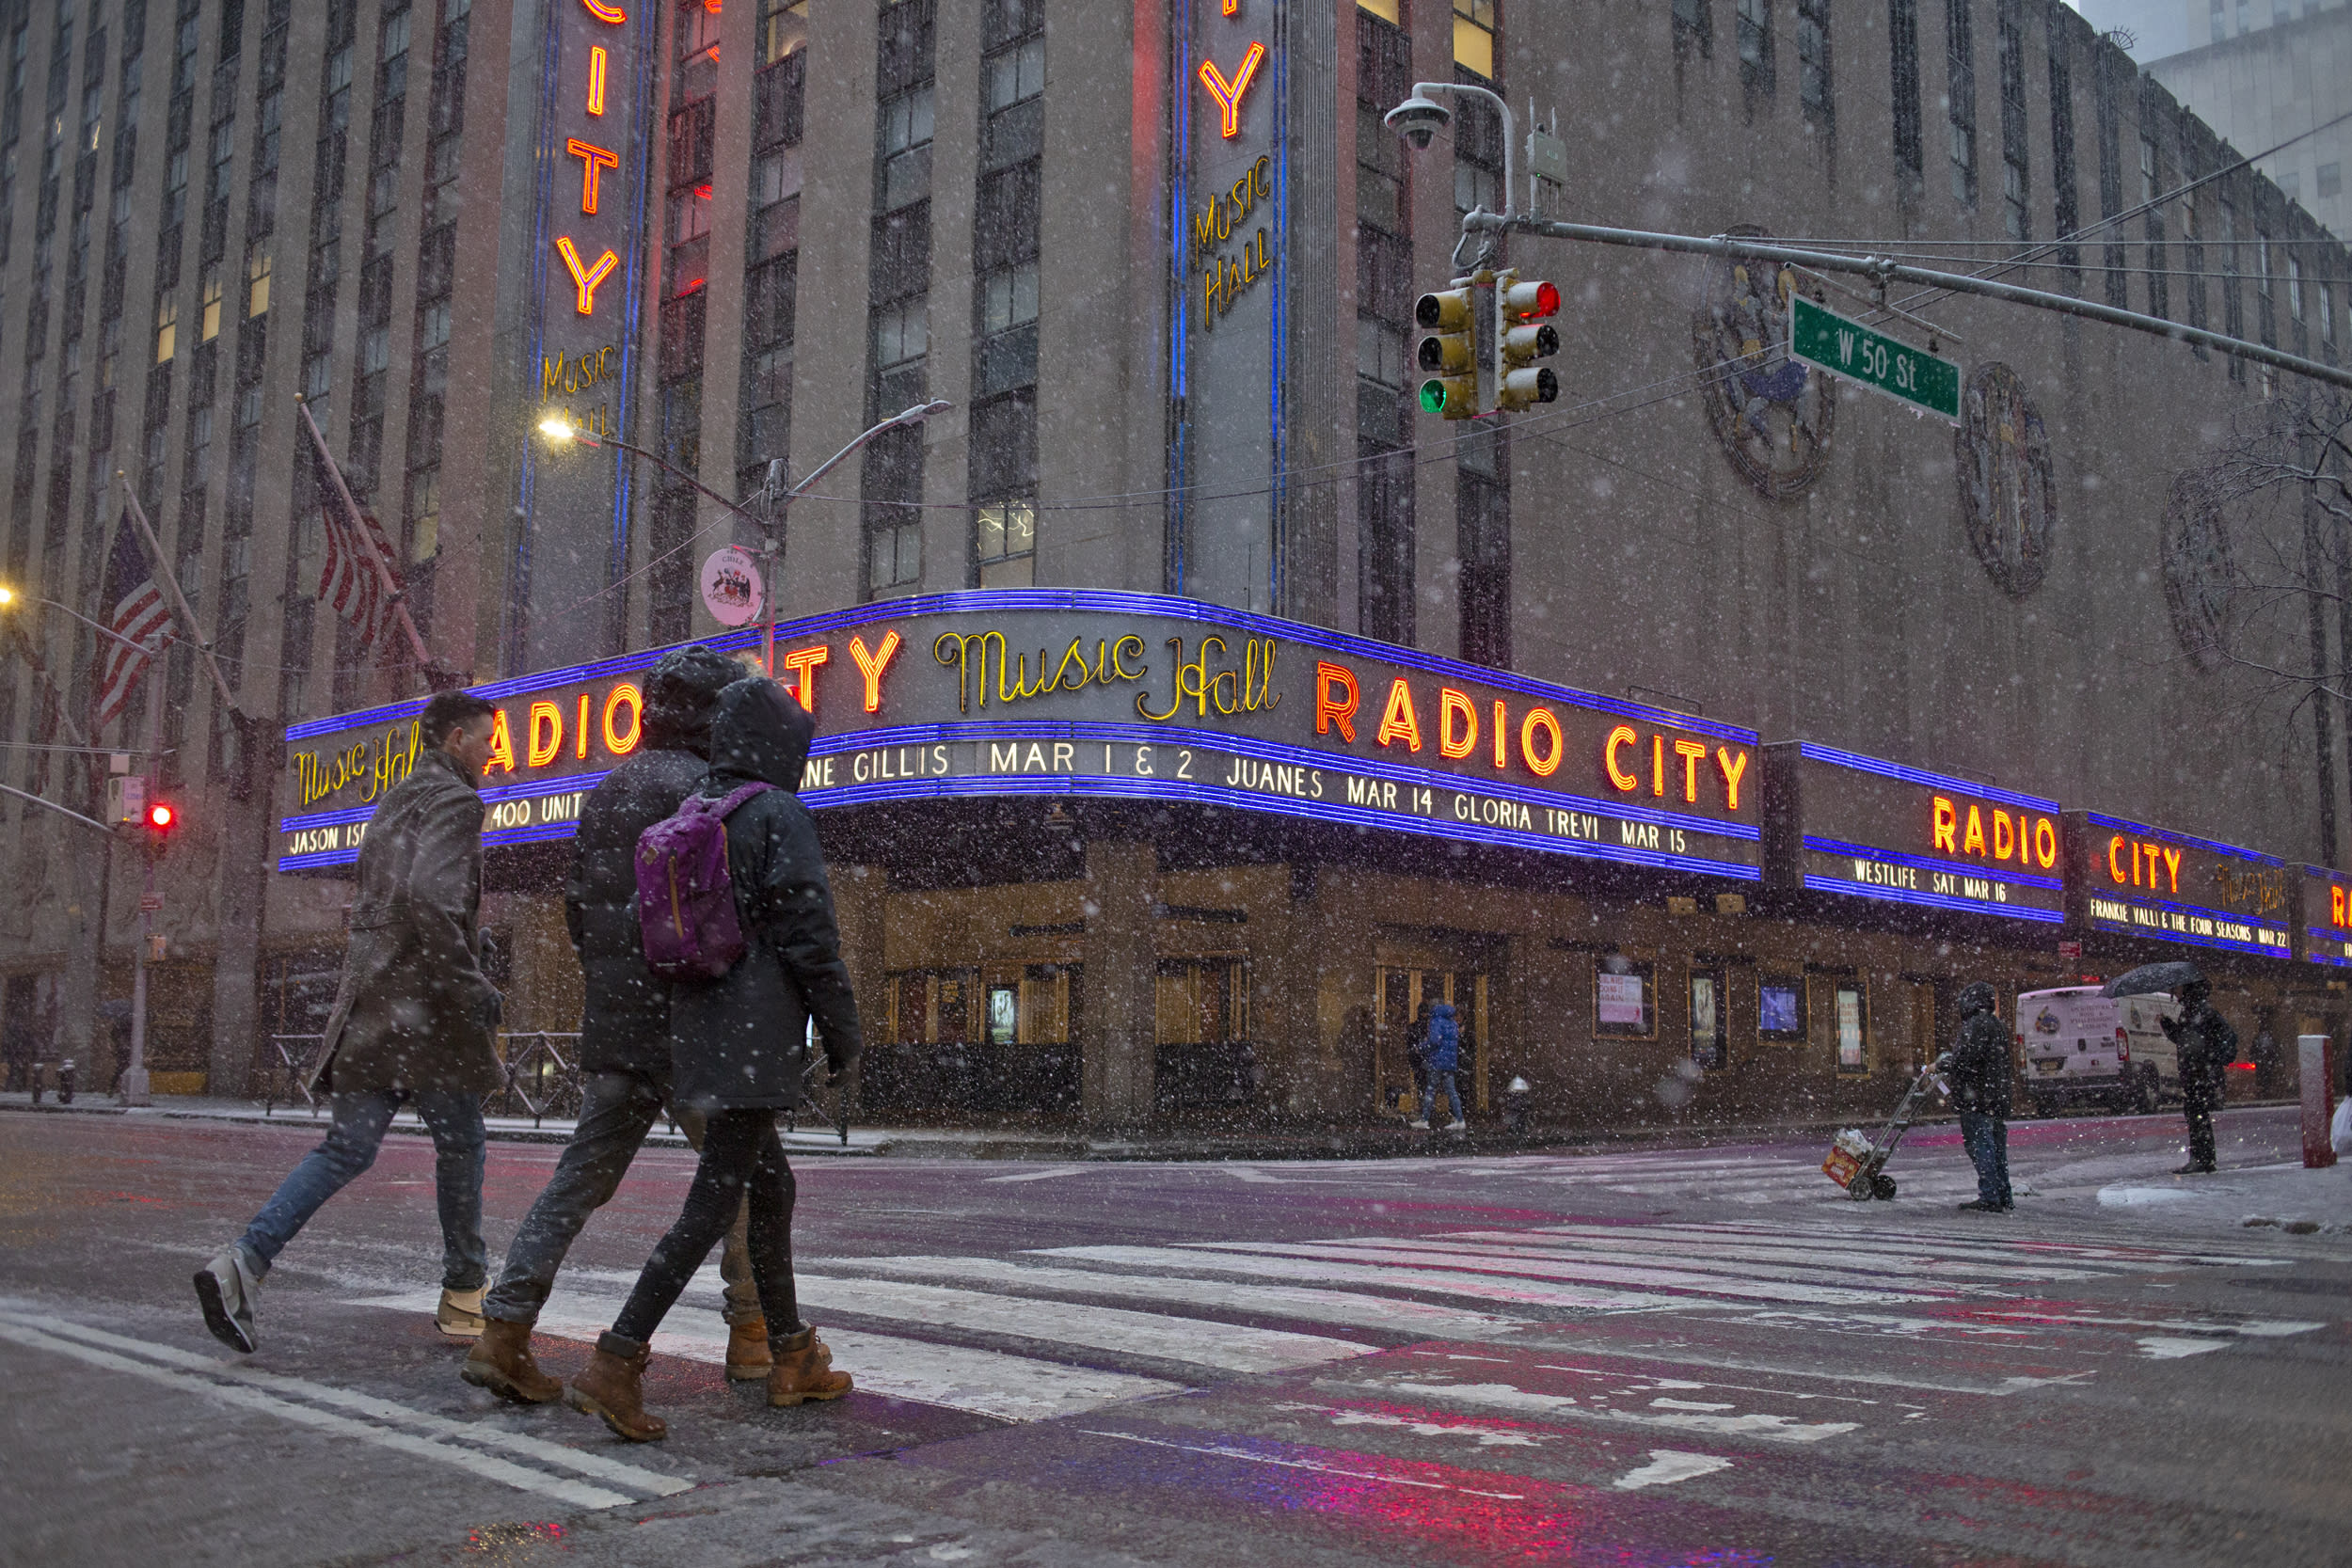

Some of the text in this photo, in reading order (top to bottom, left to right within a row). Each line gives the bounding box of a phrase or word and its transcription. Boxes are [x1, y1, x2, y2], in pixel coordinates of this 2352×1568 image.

[1198, 0, 1264, 138] Y
[557, 0, 628, 314] ITY
[1196, 157, 1269, 267] MUSIC
[1205, 232, 1269, 328] HALL
[544, 346, 614, 404] MUSIC
[1839, 328, 1917, 391] W 50 St
[785, 628, 900, 713] TY
[934, 630, 1281, 720] Music Hall
[292, 721, 423, 808] Music Hal
[482, 683, 643, 775] ADIO
[1317, 660, 1747, 810] RADIO CITY
[290, 827, 339, 855] JASON
[491, 800, 531, 829] 400
[541, 793, 583, 822] UNIT
[800, 757, 835, 788] NE
[853, 745, 947, 783] GILLIS
[991, 742, 1073, 773] MAR
[1135, 746, 1154, 775] &
[1177, 750, 1193, 780] 2
[1227, 757, 1322, 798] JUANES
[1347, 776, 1397, 808] MAR
[1413, 788, 1433, 815] 14
[1454, 795, 1532, 831] GLORIA
[1547, 808, 1598, 841] TREVI
[1622, 821, 1660, 848] MAR
[1670, 829, 1686, 853] 15
[1932, 796, 2057, 869] RADIO
[1854, 860, 2007, 902] WESTLIFE SAT. MAR 16
[2109, 835, 2181, 893] CITY
[2090, 897, 2286, 947] FRANKIE VALLI & THE FOUR SEASONS MAR 22
